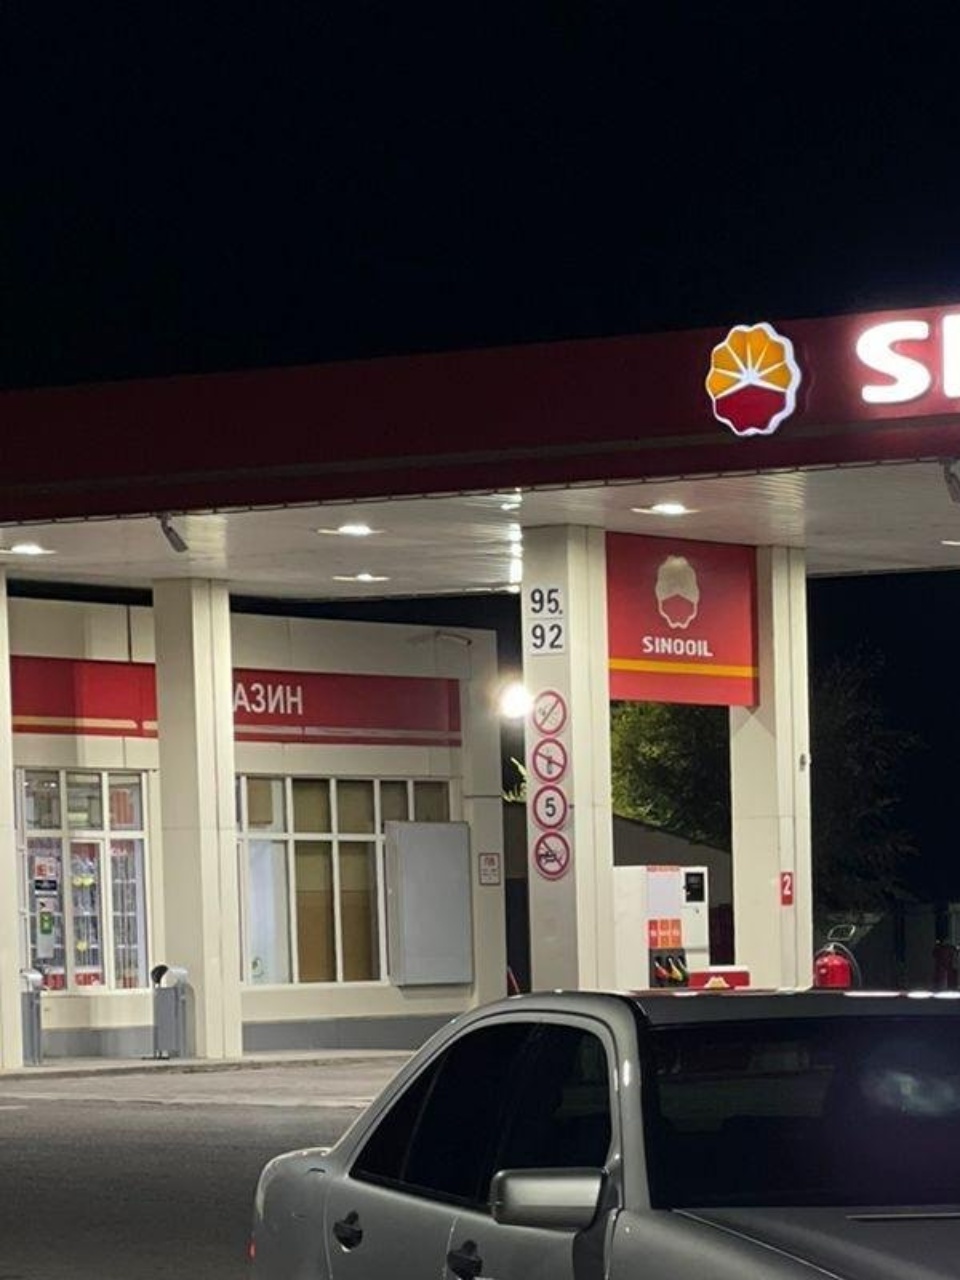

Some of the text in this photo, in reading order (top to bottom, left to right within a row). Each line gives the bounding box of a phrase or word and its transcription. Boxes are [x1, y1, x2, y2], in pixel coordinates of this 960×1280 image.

[531, 624, 563, 649] 92
[642, 636, 714, 657] SINOOIL
[233, 683, 303, 715] АЗИН
[545, 797, 556, 817] 5
[783, 875, 792, 895] 2
